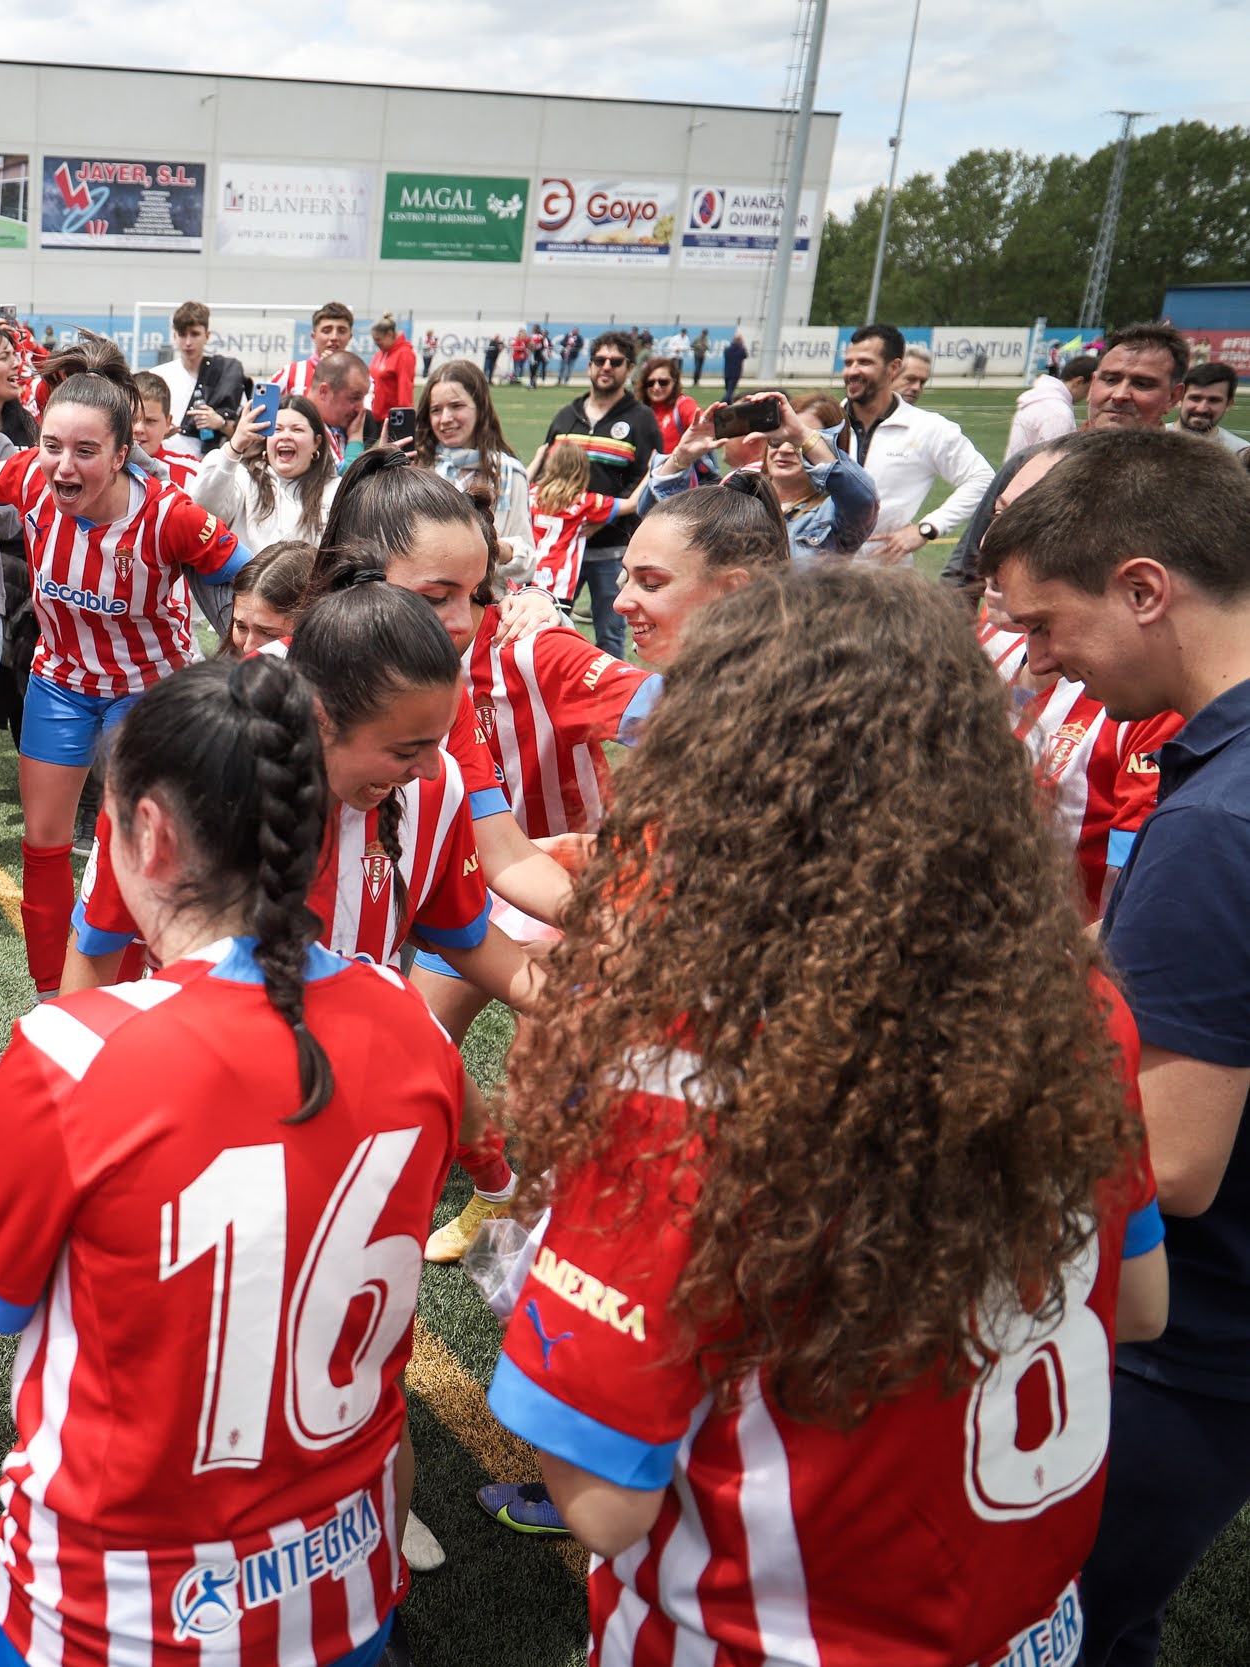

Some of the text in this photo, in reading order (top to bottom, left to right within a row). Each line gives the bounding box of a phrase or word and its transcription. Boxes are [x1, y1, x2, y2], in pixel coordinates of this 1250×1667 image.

[157, 165, 196, 187] S.L.
[249, 196, 332, 214] BLANFER
[400, 186, 477, 211] MAGAL
[587, 191, 658, 229] Goyo
[732, 195, 786, 210] AVANZA
[389, 211, 424, 221] CENTRO
[425, 213, 436, 221] DE
[937, 338, 1024, 360] LEONTUR
[36, 571, 128, 615] lecable
[159, 1126, 423, 1477] 16
[529, 1245, 647, 1342] IMERKA
[245, 1492, 378, 1604] INTEGRA
